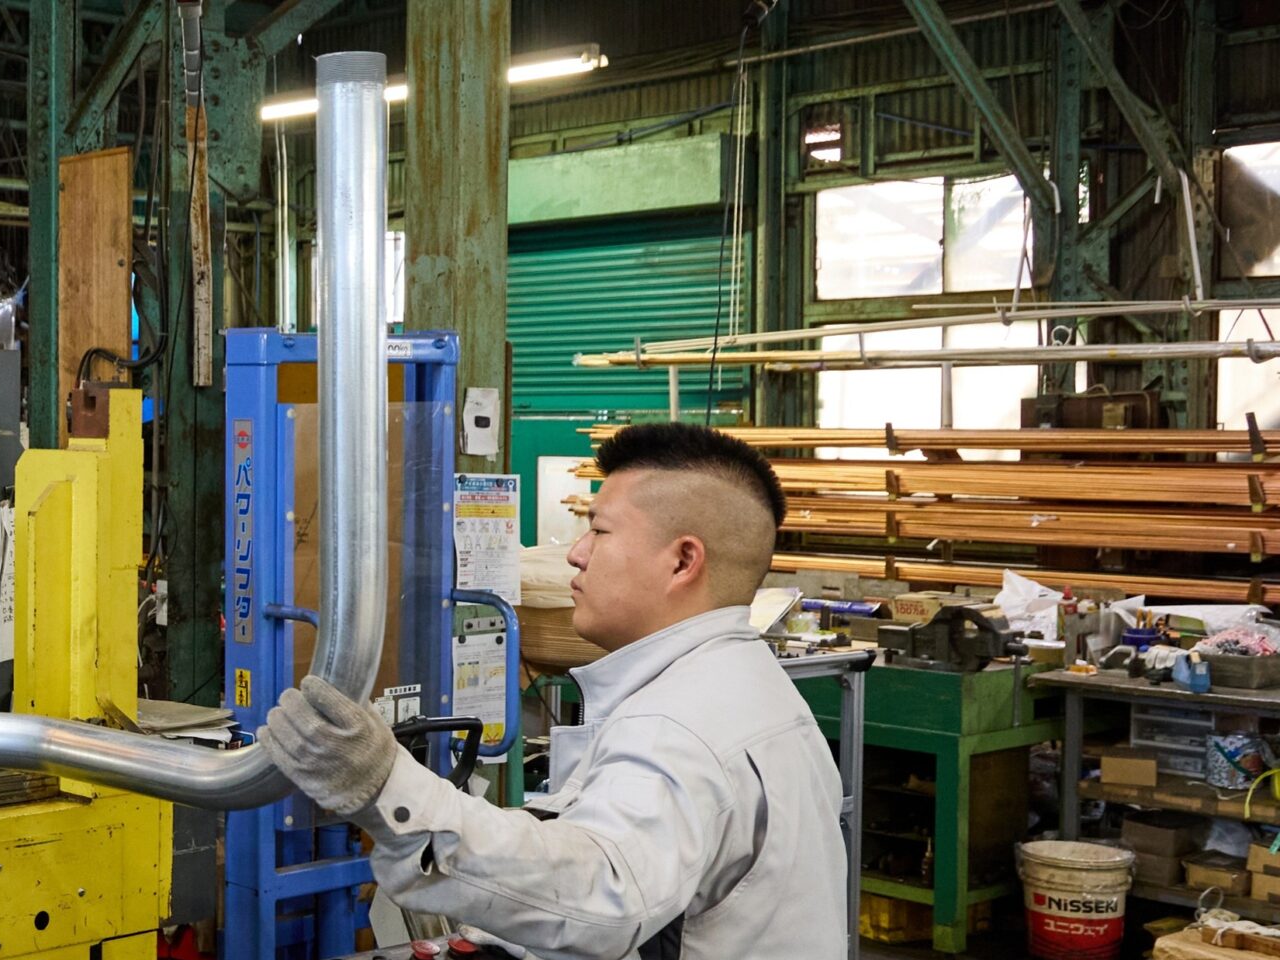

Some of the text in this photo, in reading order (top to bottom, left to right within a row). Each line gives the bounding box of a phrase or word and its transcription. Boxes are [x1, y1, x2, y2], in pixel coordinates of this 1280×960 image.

[235, 457, 252, 636] パワーリフター
[1044, 918, 1109, 938] ユニウェイ
